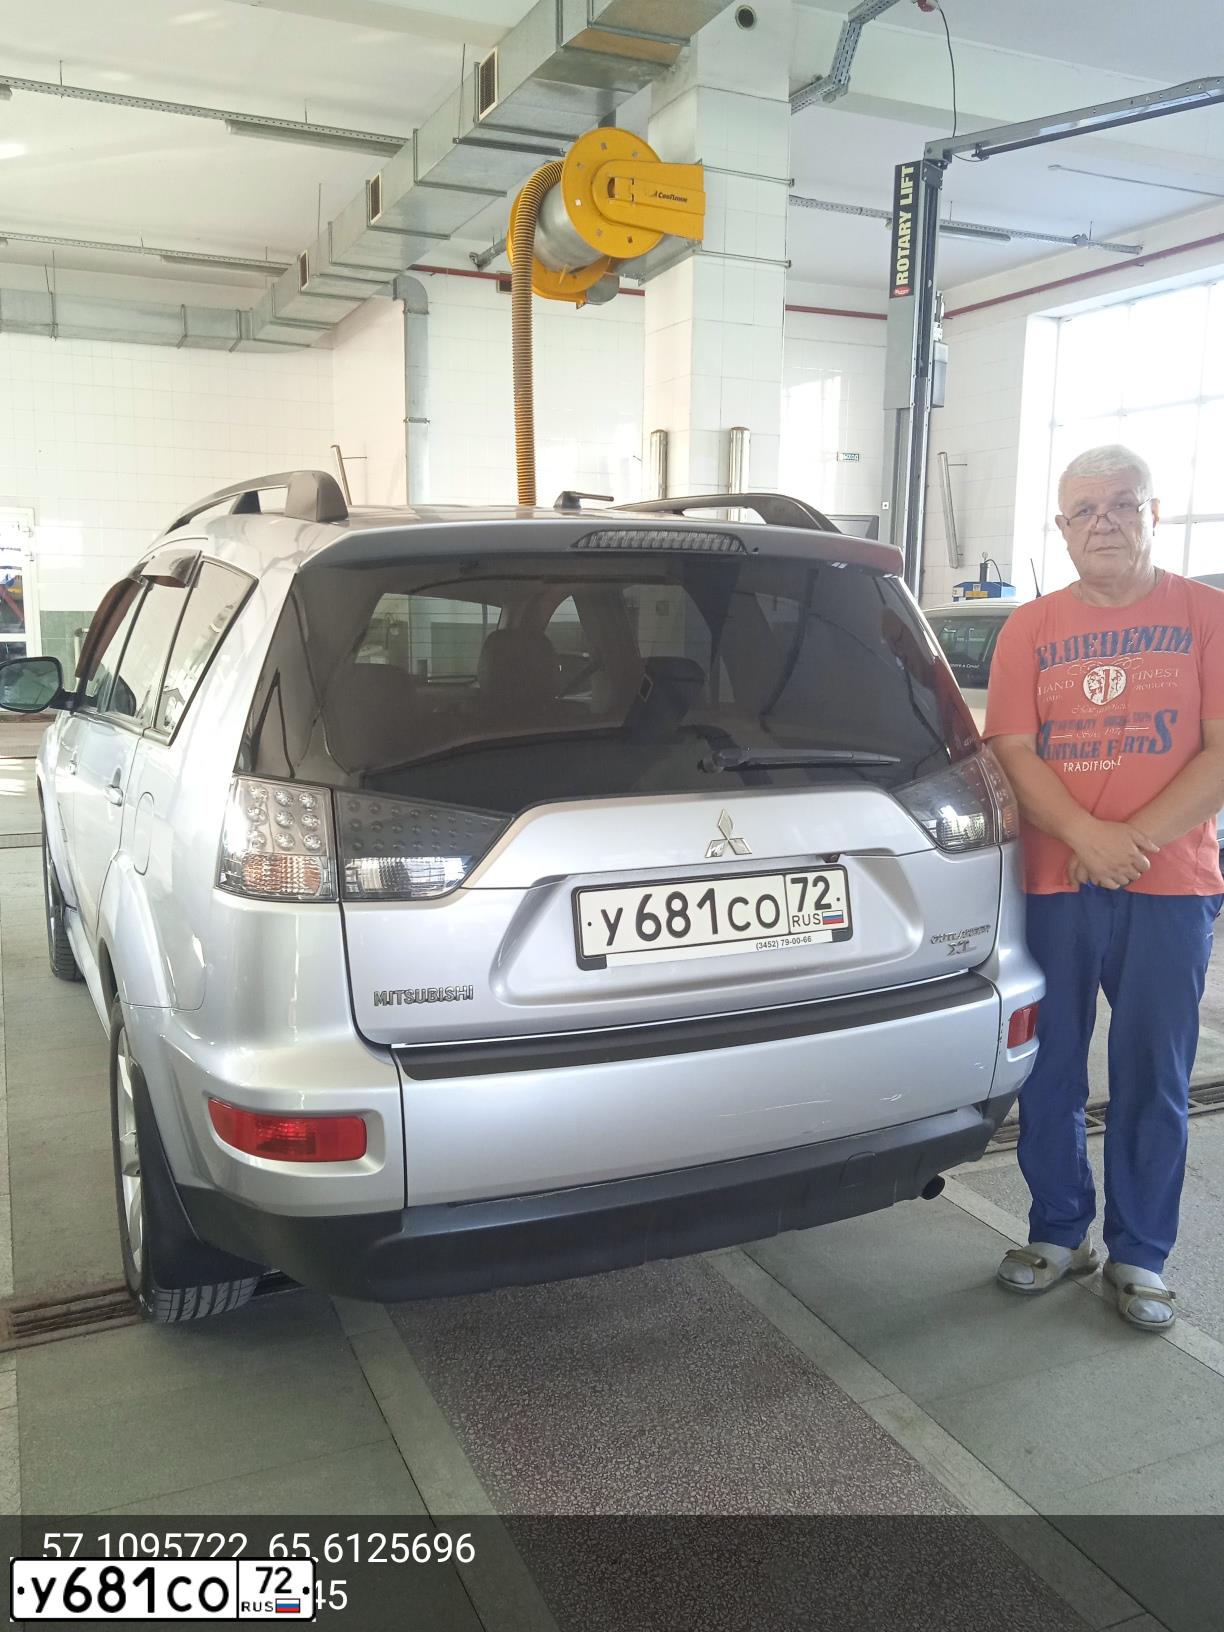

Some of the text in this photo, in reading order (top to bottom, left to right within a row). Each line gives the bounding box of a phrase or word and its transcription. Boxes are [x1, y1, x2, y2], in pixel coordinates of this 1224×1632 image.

[899, 165, 915, 206] LIFT
[895, 210, 913, 286] ROTARY
[1106, 708, 1179, 758] PRTS
[790, 875, 832, 912] 72
[792, 912, 821, 928] RUS
[755, 935, 812, 951] (3452) 79-00-66
[373, 984, 474, 1007] MITSUBISHI
